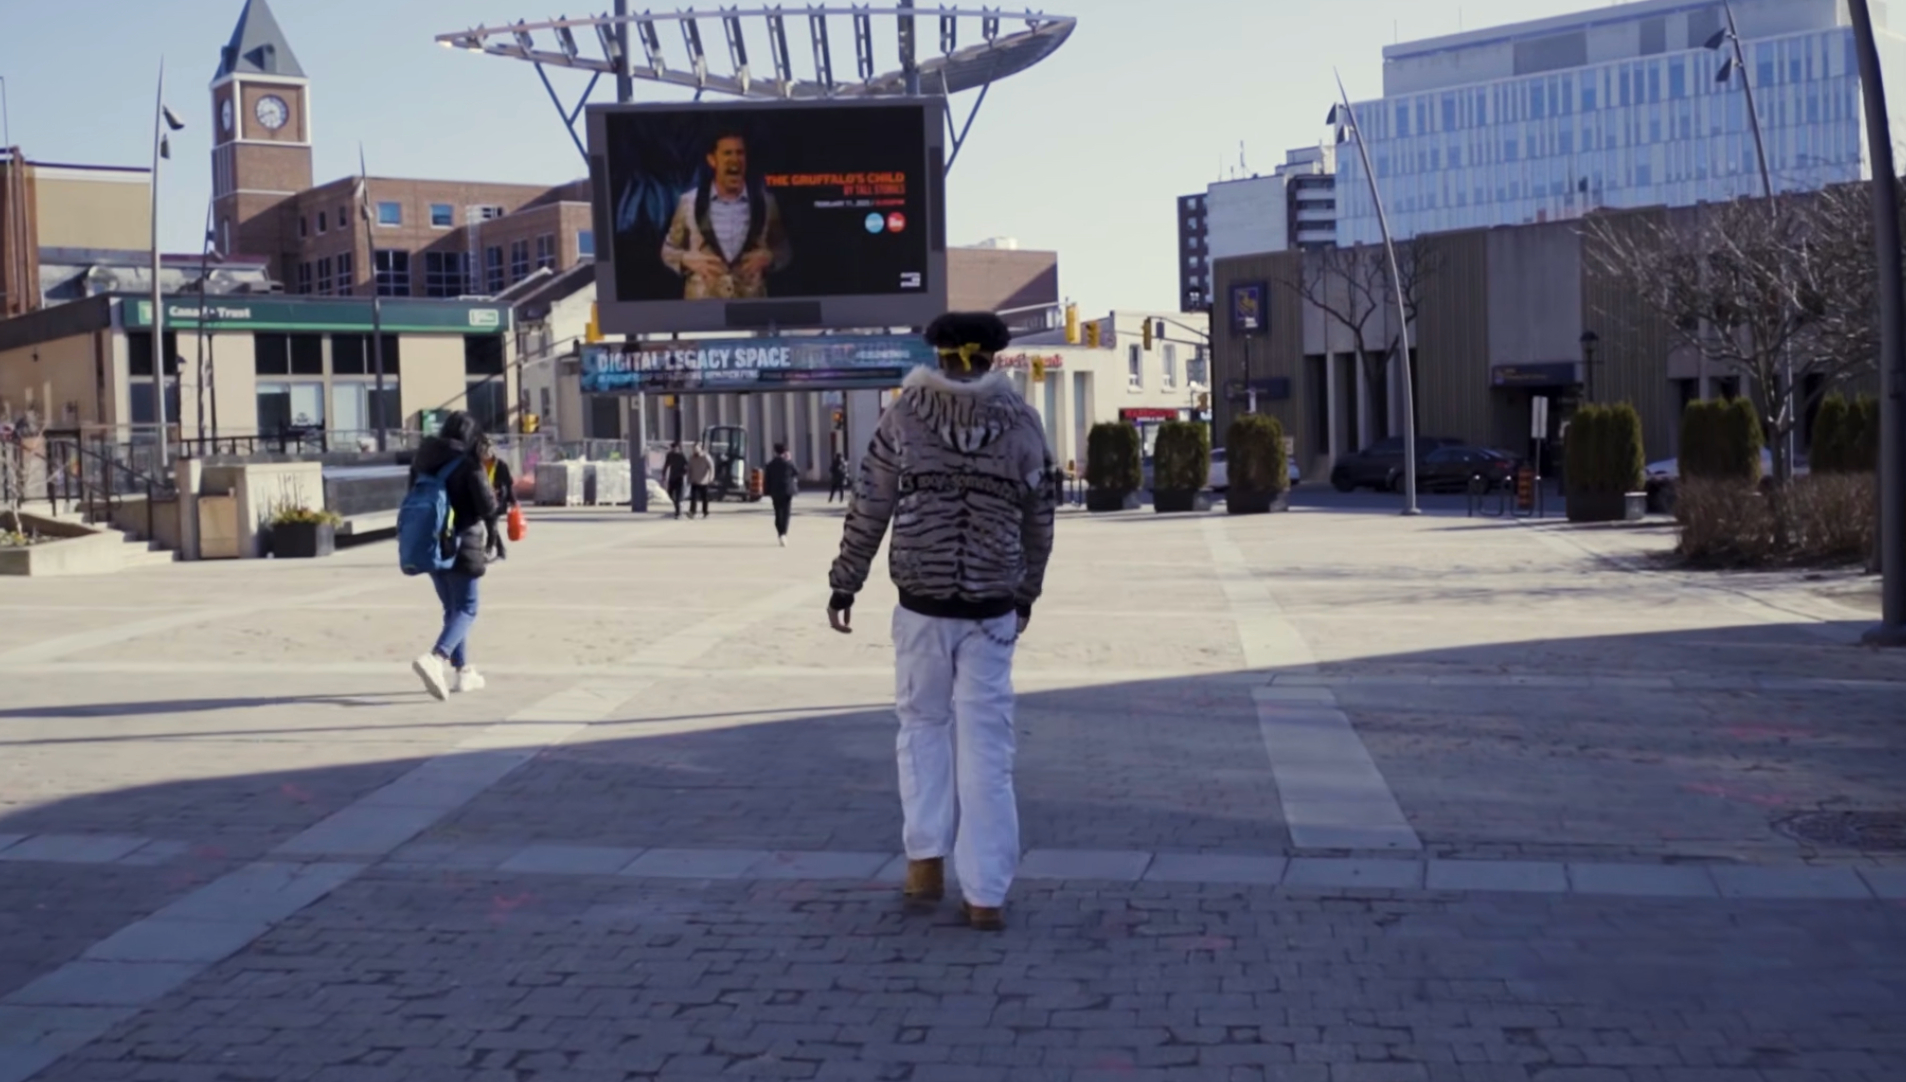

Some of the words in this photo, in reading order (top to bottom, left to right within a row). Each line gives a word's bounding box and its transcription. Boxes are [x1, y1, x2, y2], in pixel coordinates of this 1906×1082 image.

[766, 175, 788, 185] THE
[791, 173, 864, 185] GRUFFALO'S
[867, 172, 905, 183] CHILD
[597, 352, 660, 372] DIGITAL
[664, 350, 731, 371] LEGACY
[735, 347, 791, 369] SPACE
